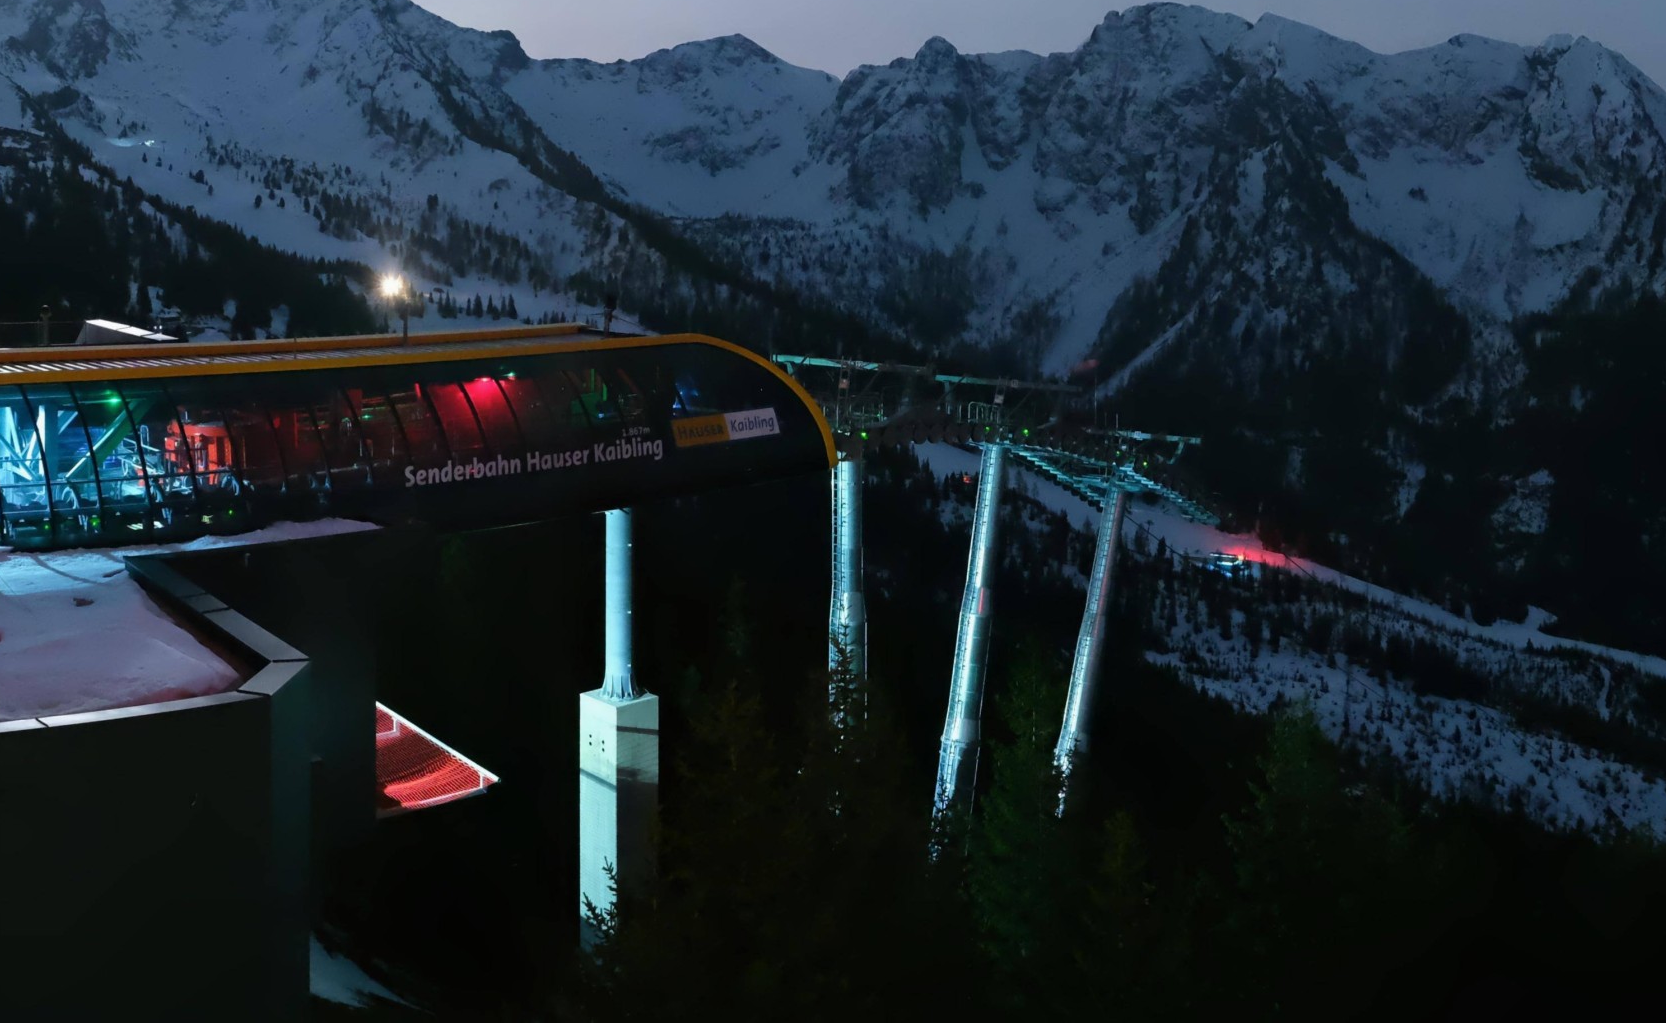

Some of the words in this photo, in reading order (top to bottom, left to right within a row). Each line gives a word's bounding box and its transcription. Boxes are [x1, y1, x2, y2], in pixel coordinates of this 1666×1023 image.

[678, 423, 725, 440] HAUSER
[730, 415, 776, 434] Kaibling
[404, 455, 521, 487] Senderbahn
[527, 447, 590, 473] Hauser
[594, 437, 664, 463] Kaibling
